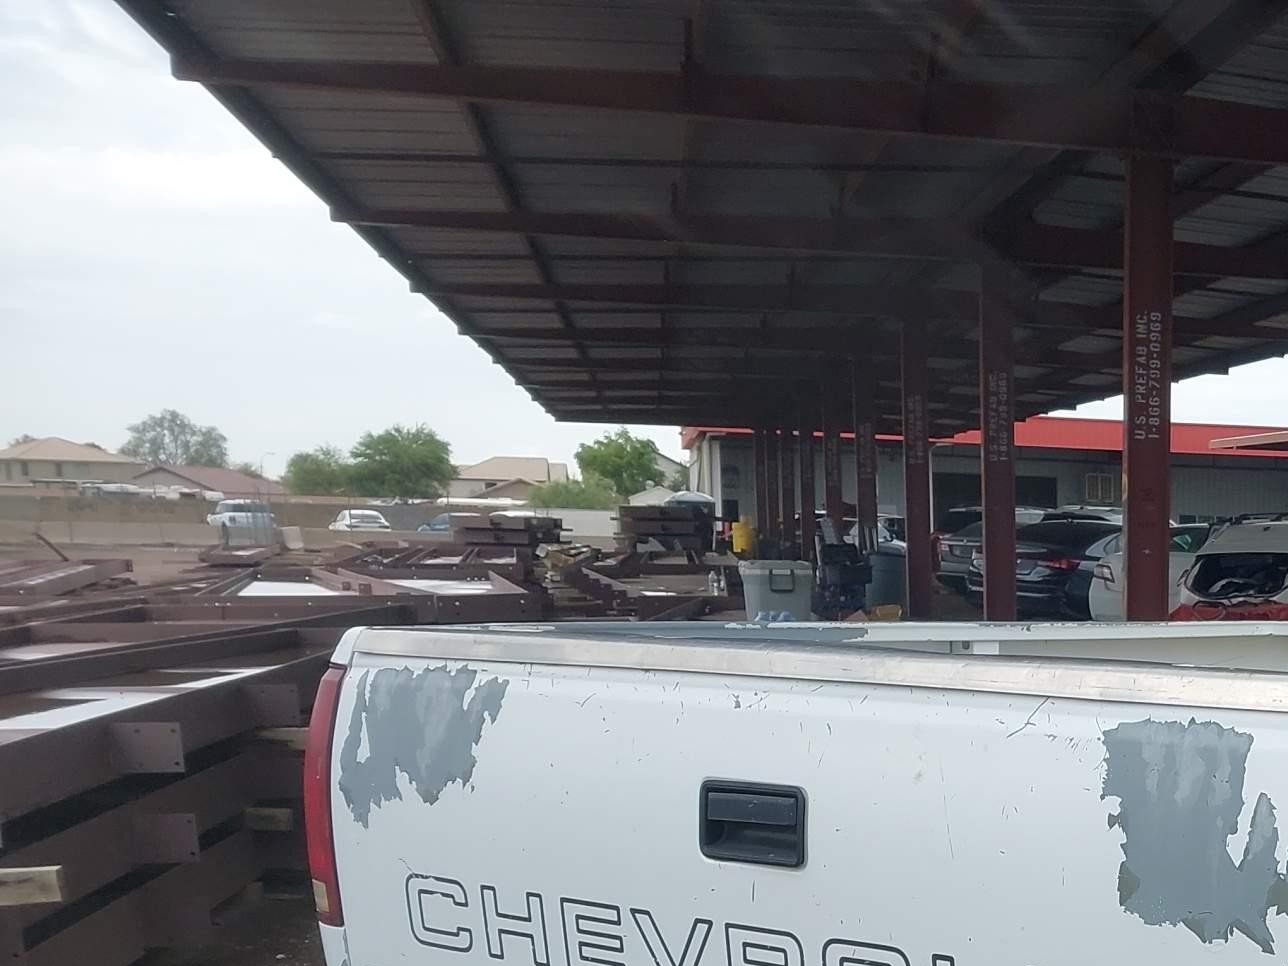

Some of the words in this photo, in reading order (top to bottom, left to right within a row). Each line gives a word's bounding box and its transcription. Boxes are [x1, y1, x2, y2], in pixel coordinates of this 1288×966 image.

[1135, 310, 1149, 339] INC.
[1135, 346, 1148, 404] PREFAB
[1147, 312, 1162, 439] 1-866-799-0969
[1134, 411, 1146, 440] U.S.
